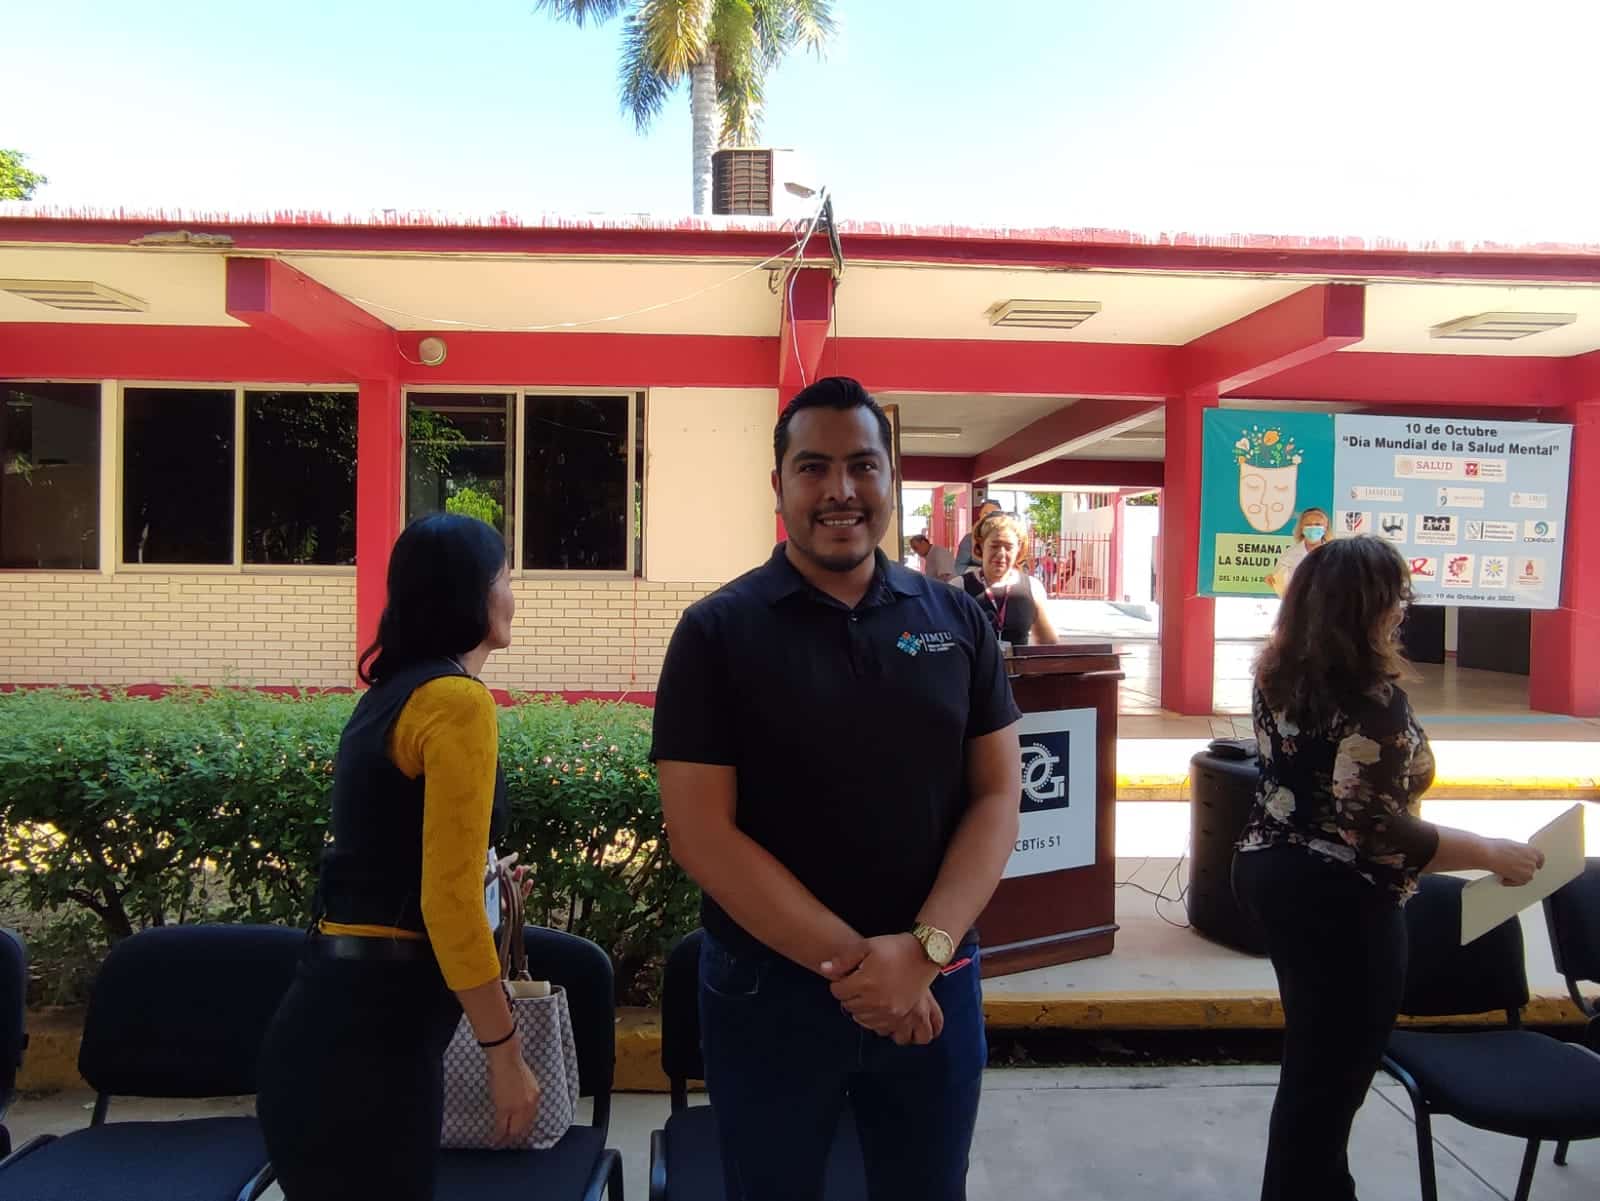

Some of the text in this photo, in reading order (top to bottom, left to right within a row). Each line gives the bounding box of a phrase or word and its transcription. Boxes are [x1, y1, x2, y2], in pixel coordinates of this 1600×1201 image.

[1405, 423, 1498, 437] 10 de Octubre
[1375, 437, 1427, 450] Mundial
[1431, 440, 1447, 451] de
[1452, 440, 1463, 452] la
[1468, 441, 1505, 454] Salud
[1416, 461, 1453, 471] SALUD
[1237, 543, 1282, 554] SEMANA
[1218, 555, 1231, 565] LA
[1235, 556, 1271, 567] SALUD
[1014, 836, 1061, 852] CBTis 51
